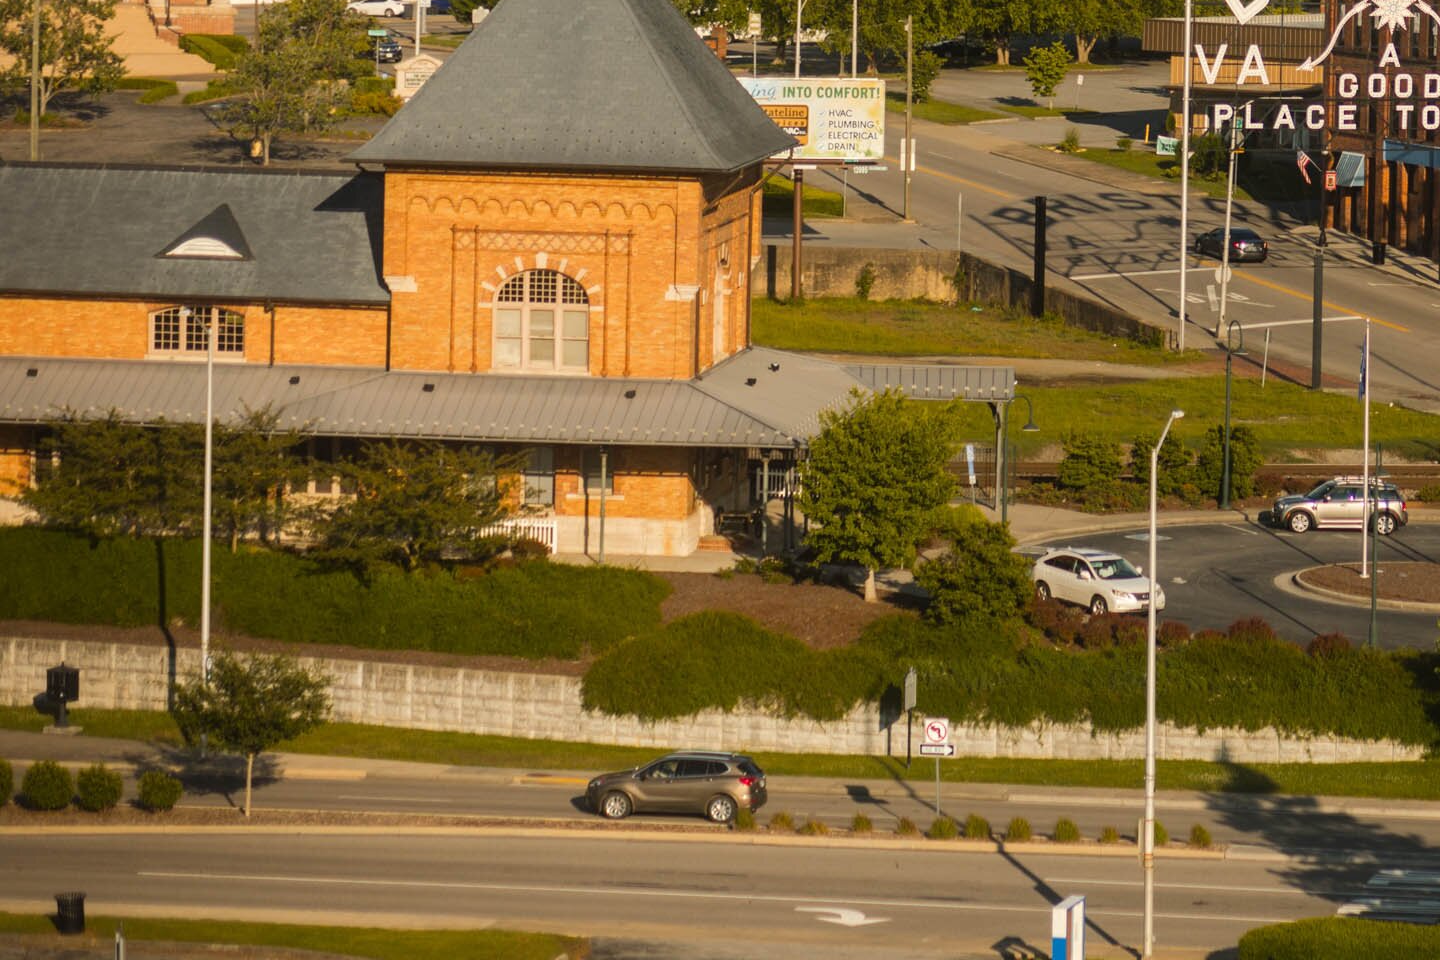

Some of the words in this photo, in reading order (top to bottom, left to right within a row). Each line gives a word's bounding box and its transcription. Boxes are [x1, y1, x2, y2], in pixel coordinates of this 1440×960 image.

[1379, 42, 1400, 68] A
[1194, 43, 1270, 85] VA
[783, 86, 812, 99] INTO
[816, 86, 880, 99] COMFORT!
[764, 107, 805, 117] tateline
[828, 109, 853, 118] HVAC
[1214, 104, 1357, 130] PLACE
[1396, 104, 1440, 130] TO
[828, 121, 874, 129] PLUMBING
[828, 132, 878, 140] ELECTRICAL
[827, 143, 856, 151] DRAIN
